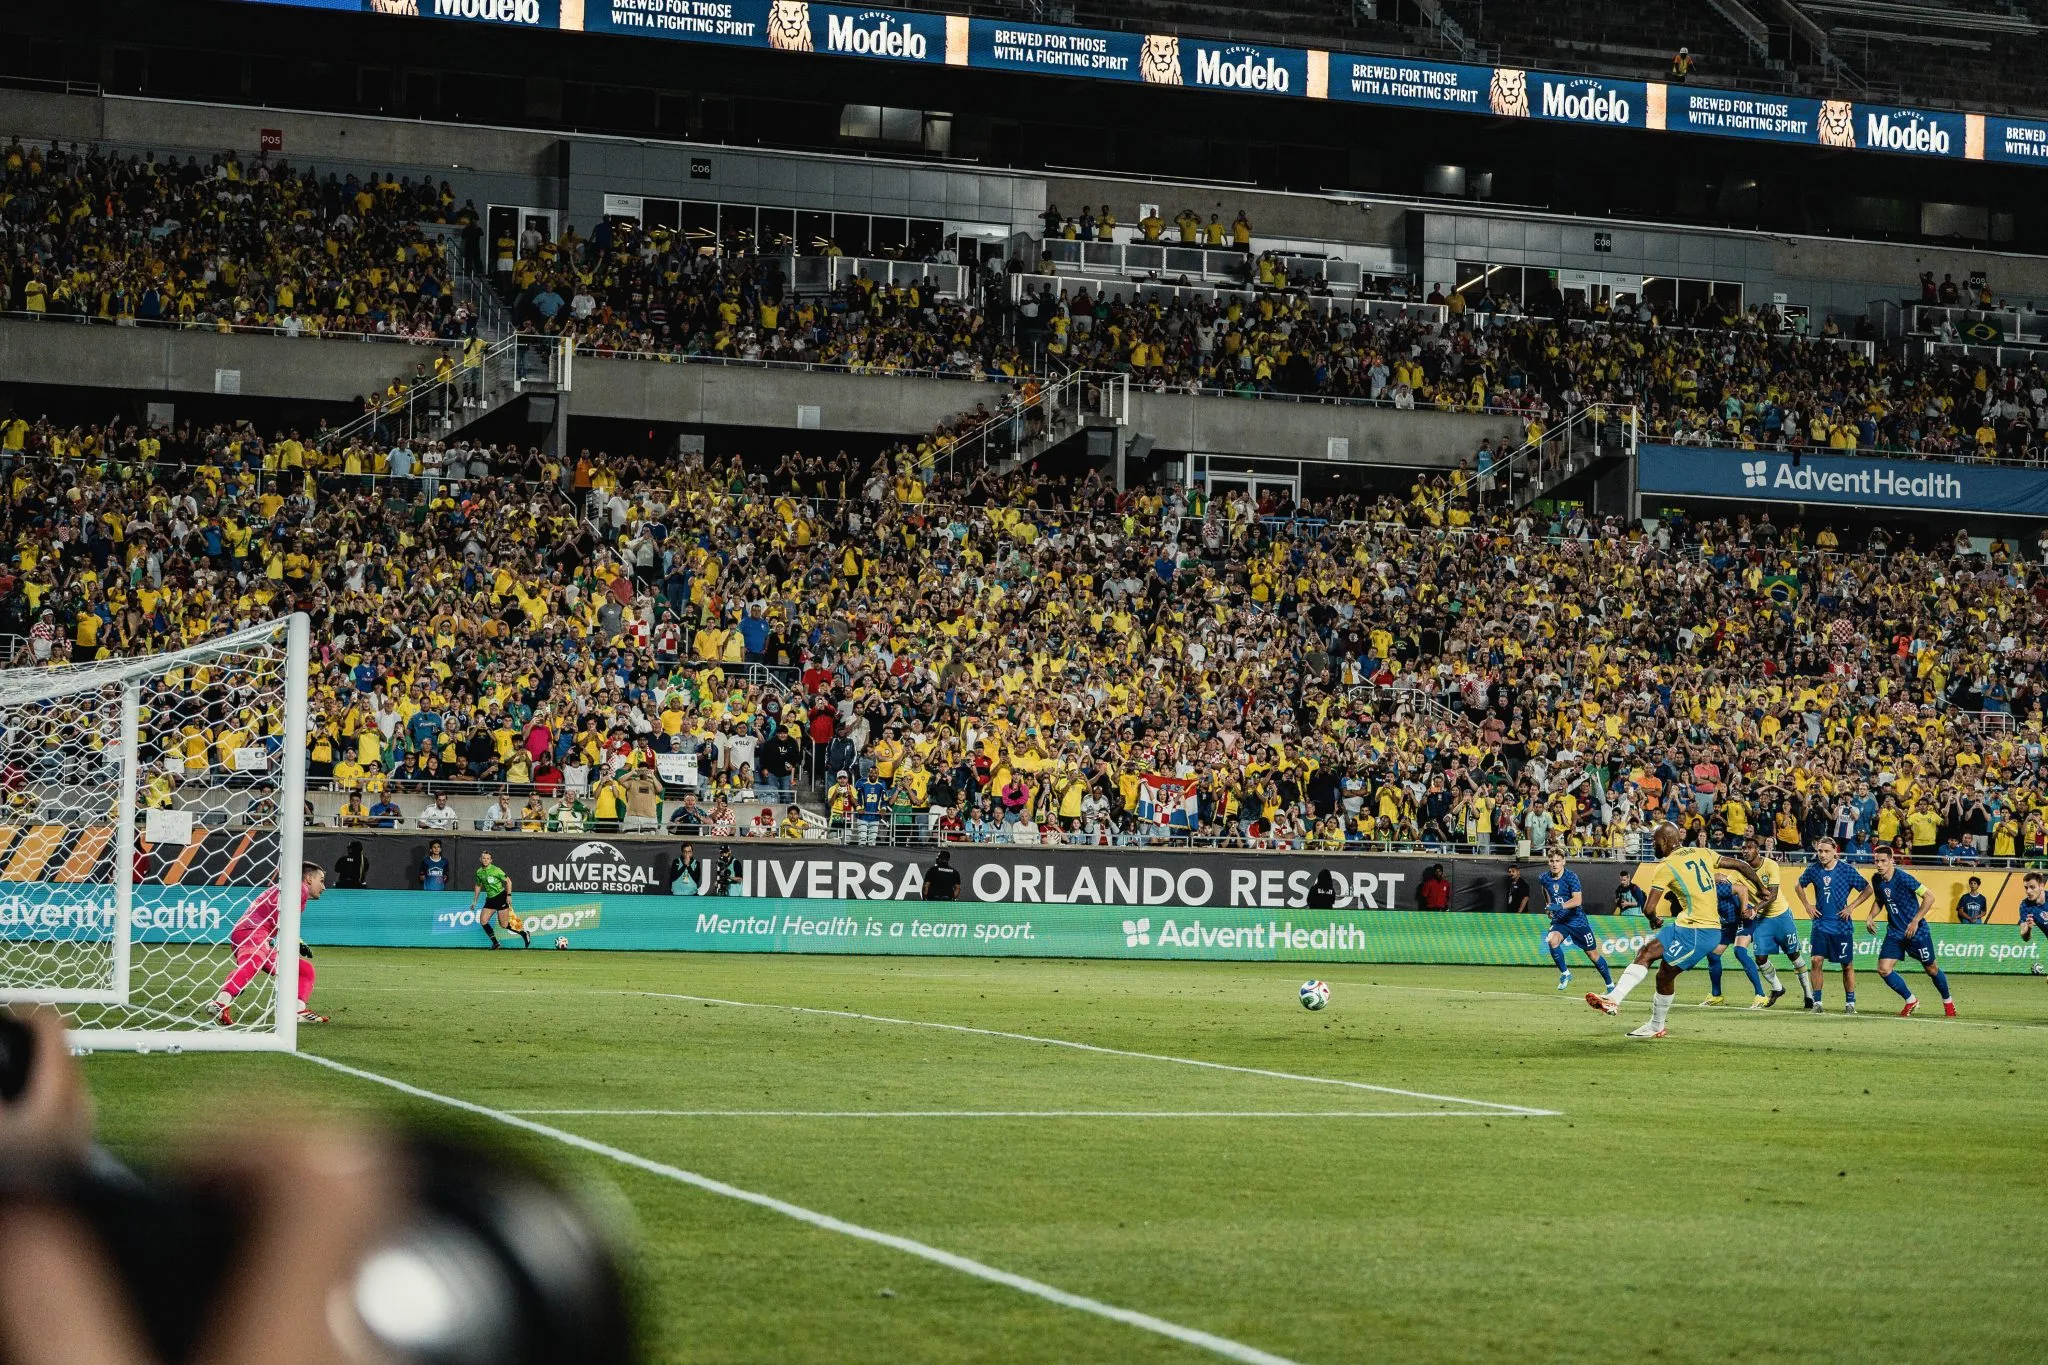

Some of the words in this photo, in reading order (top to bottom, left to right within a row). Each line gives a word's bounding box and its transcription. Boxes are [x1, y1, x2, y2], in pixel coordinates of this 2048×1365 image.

[613, 0, 663, 12] BREWED
[666, 0, 690, 14] FOR
[692, 2, 732, 18] THOSE
[859, 12, 896, 24] CERVEZA
[612, 10, 643, 26] WITH
[646, 15, 654, 28] A
[657, 15, 713, 33] FIGHTING
[716, 20, 755, 37] SPIRIT
[828, 14, 926, 59] Modelo
[995, 29, 1042, 47] BREWED
[1045, 34, 1067, 50] FOR
[1069, 37, 1107, 53] THOSE
[993, 45, 1024, 61] WITH
[1026, 49, 1034, 62] A
[1036, 49, 1089, 67] FIGHTING
[1091, 55, 1129, 71] SPIRIT
[1225, 46, 1260, 58] CERVEZA
[1196, 48, 1289, 92] Modelo
[1352, 63, 1397, 80] BREWED
[1400, 68, 1420, 83] FOR
[1422, 70, 1457, 86] THOSE
[1351, 79, 1380, 94] WITH
[1382, 82, 1389, 96] A
[1391, 83, 1441, 100] FIGHTING
[1443, 89, 1478, 103] SPIRIT
[1569, 79, 1602, 91] CERVEZA
[1542, 82, 1630, 124] Modelo
[1690, 96, 1731, 112] BREWED
[1733, 100, 1753, 114] FOR
[1755, 102, 1788, 117] THOSE
[1688, 111, 1715, 126] WITH
[1717, 114, 1724, 127] A
[1726, 114, 1773, 131] FIGHTING
[1775, 120, 1808, 134] SPIRIT
[1893, 110, 1925, 122] CERVEZA
[1867, 113, 1950, 154] Modelo
[2006, 126, 2046, 142] BREWED
[2005, 141, 2030, 155] WITH
[2032, 143, 2039, 156] A
[1774, 463, 1961, 499] AdventHealth
[532, 863, 660, 886] UNIVERSAL
[697, 858, 925, 900] IVERSA
[972, 863, 1214, 906] ORLANDO
[1230, 869, 1405, 909] RESORT
[1684, 857, 1715, 892] 21
[546, 881, 599, 892] ORLANDO
[602, 882, 646, 893] RESORT
[1823, 892, 1831, 904] 7
[508, 908, 597, 935] OOD?”
[695, 913, 776, 935] Mental
[782, 915, 858, 936] Health
[865, 916, 883, 937] is
[889, 922, 904, 937] a
[911, 919, 967, 938] team
[974, 921, 1035, 944] sport.
[1157, 919, 1366, 950] AdventHealth
[1583, 932, 1594, 944] 19
[1786, 933, 1797, 945] 26
[1668, 940, 1683, 957] 21
[1840, 942, 1848, 954] 7
[1918, 947, 1930, 959] 15
[1937, 940, 1984, 958] team
[1989, 942, 2040, 962] sport.
